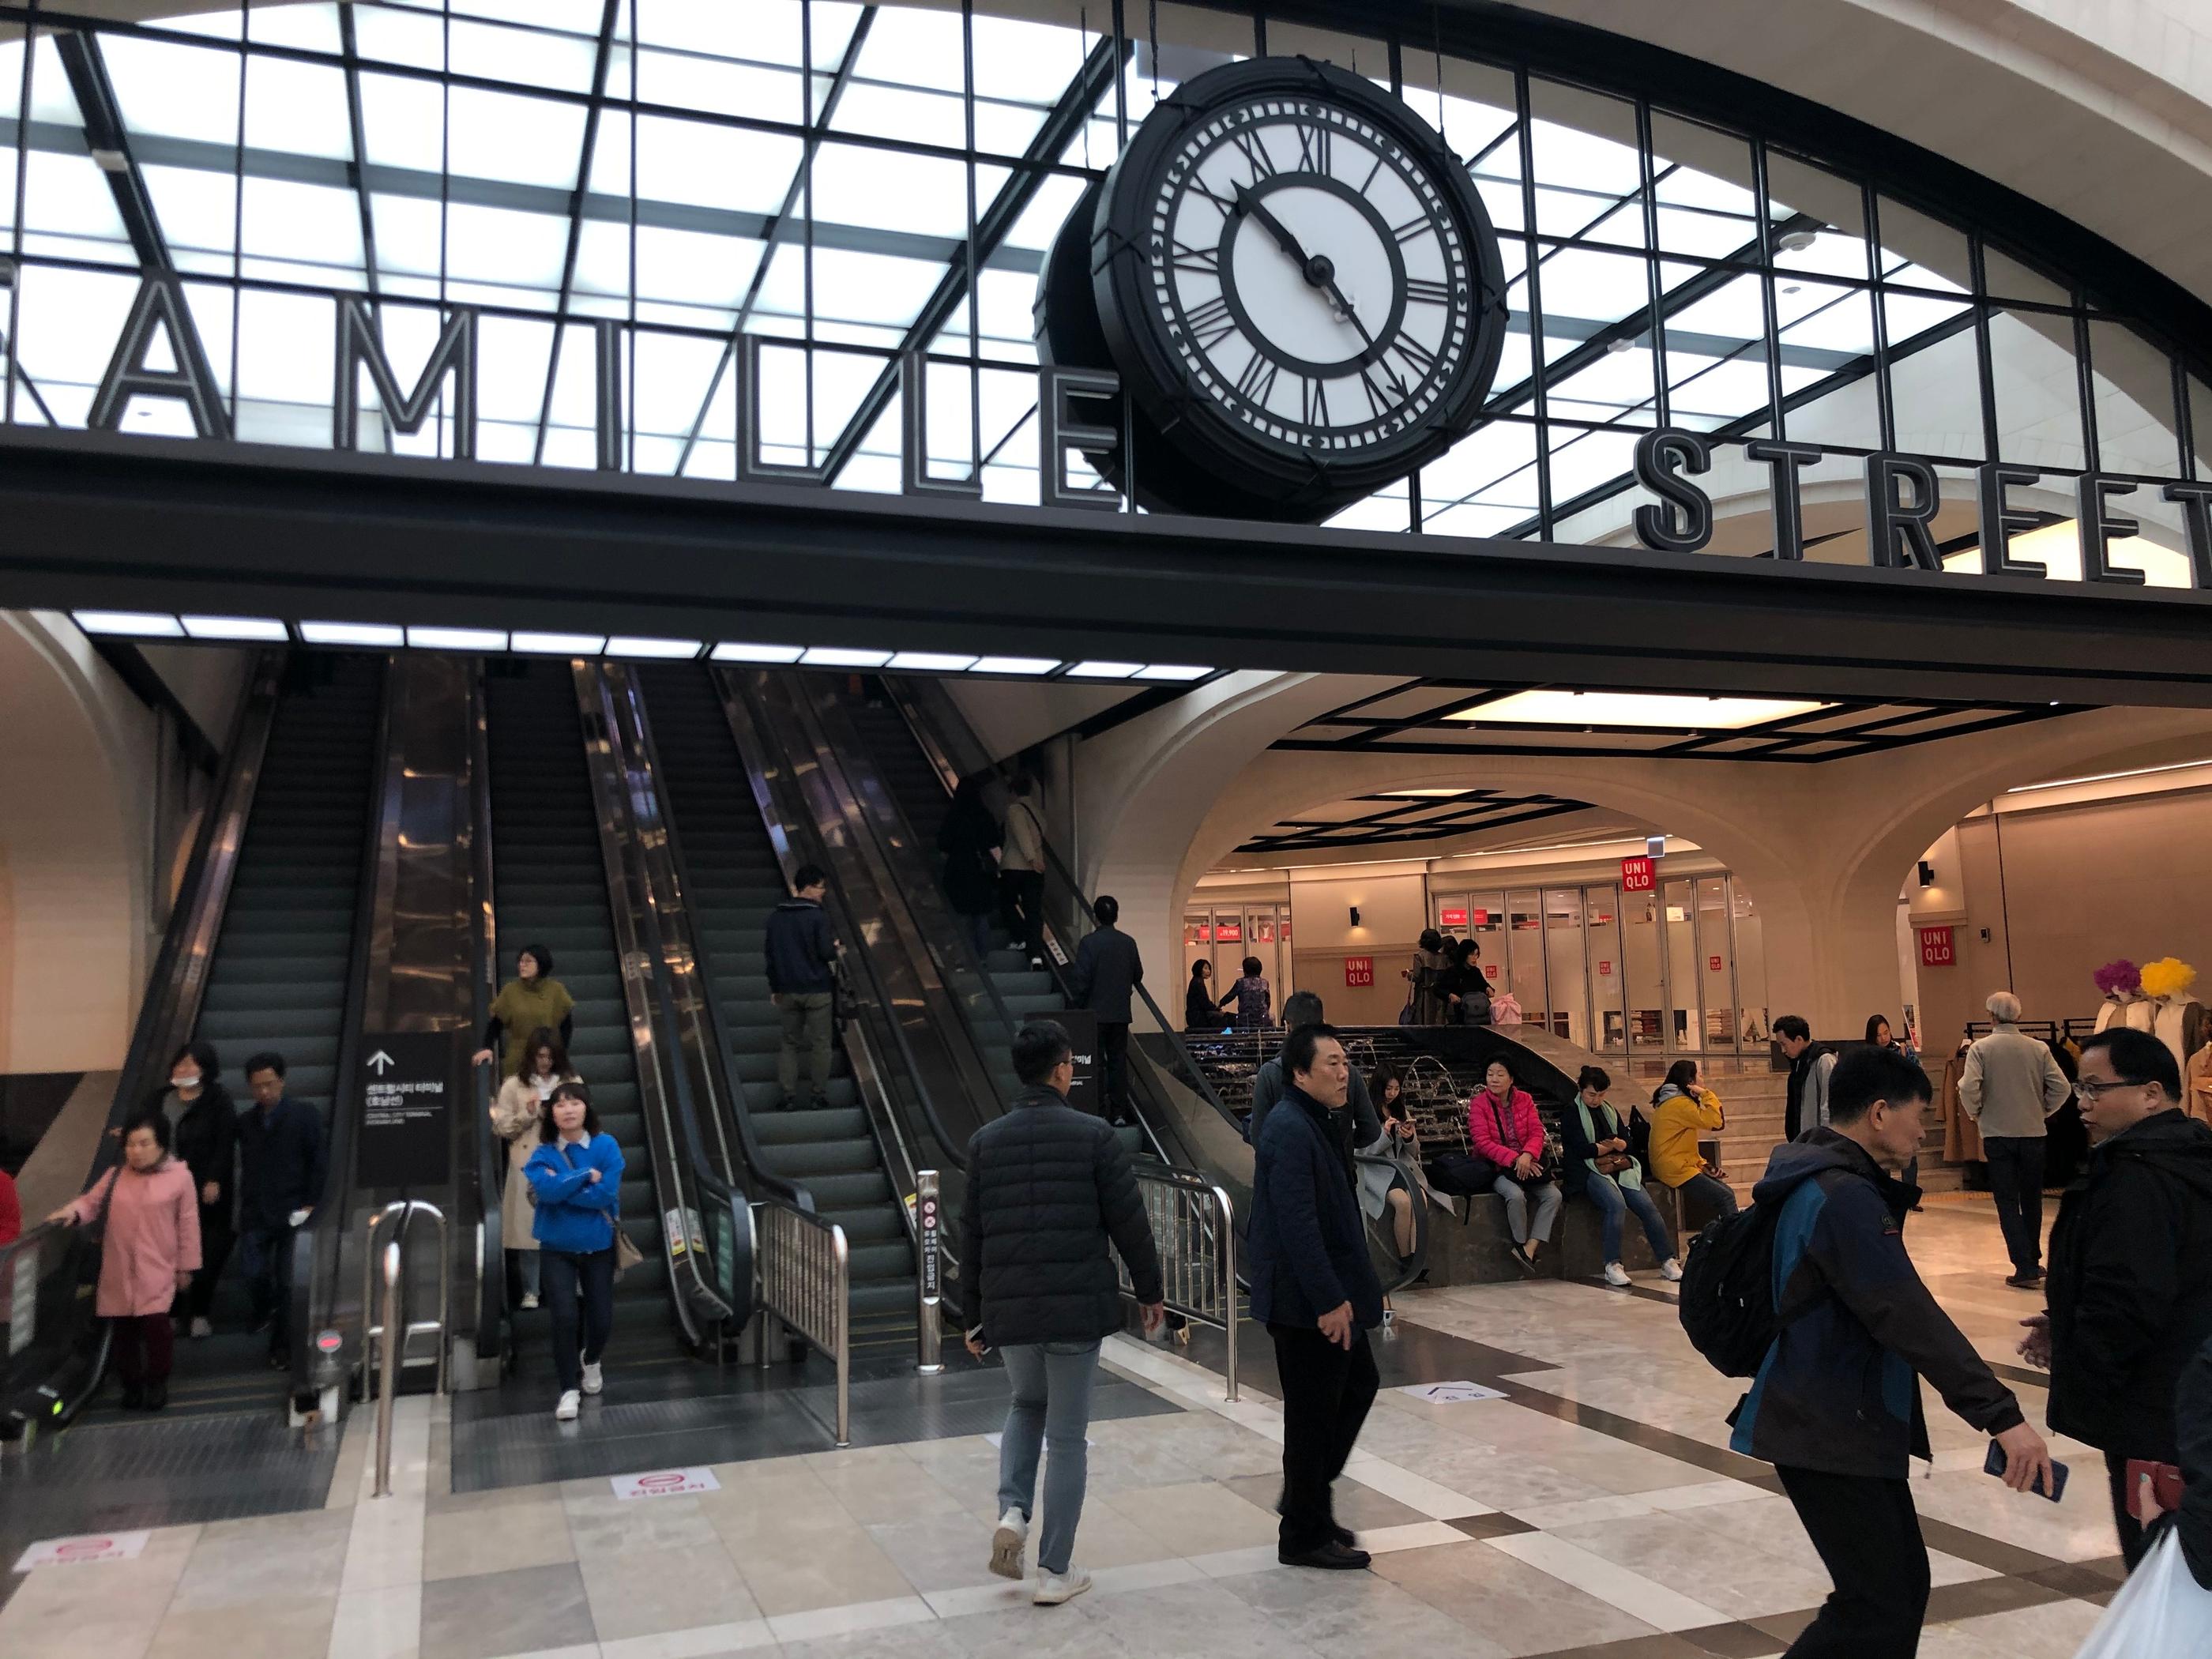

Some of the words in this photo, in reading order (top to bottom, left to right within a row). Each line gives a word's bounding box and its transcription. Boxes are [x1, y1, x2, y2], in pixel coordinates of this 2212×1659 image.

[0, 254, 1125, 510] AMILLE
[1632, 427, 2212, 589] STREET
[1624, 861, 1646, 875] UNI
[1626, 875, 1649, 890] QLO
[1924, 931, 1947, 945] UNI
[1925, 946, 1950, 963] QLO
[1348, 960, 1367, 971] UNI
[1349, 972, 1370, 985] QLO
